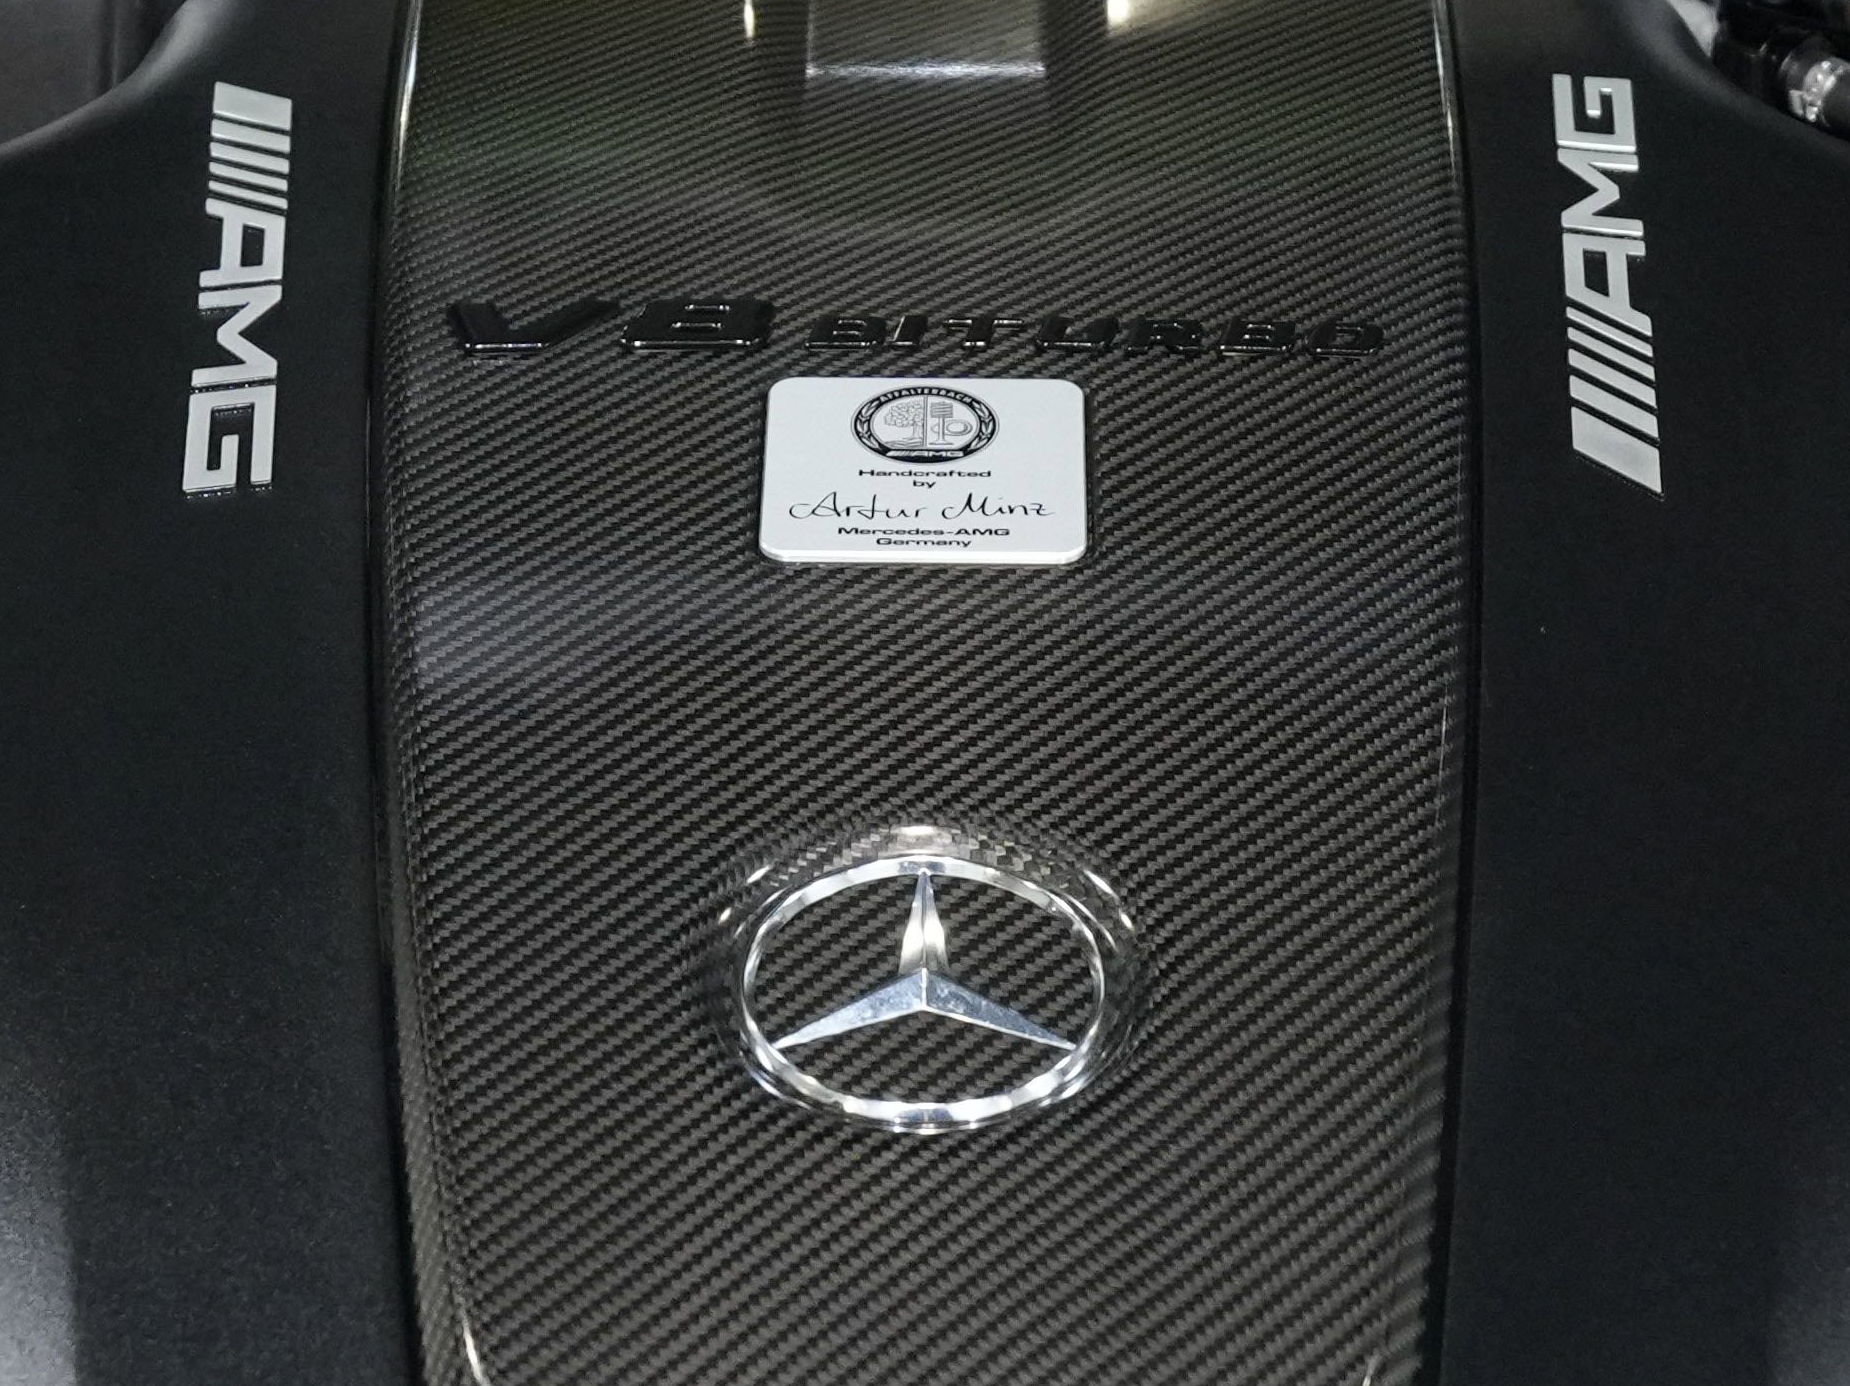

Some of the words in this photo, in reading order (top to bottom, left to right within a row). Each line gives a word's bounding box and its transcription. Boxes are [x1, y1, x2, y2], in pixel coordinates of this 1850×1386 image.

[1552, 72, 1654, 338] AMG
[451, 298, 777, 355] V8
[804, 314, 1386, 359] BITURBO
[182, 196, 287, 493] AMG
[879, 387, 973, 404] AFFALTERBACH
[858, 468, 992, 478] Handcrafted
[912, 479, 937, 489] by
[788, 490, 929, 520] Artur
[837, 526, 1011, 537] Mercedes-AMG
[875, 537, 973, 548] Germany
